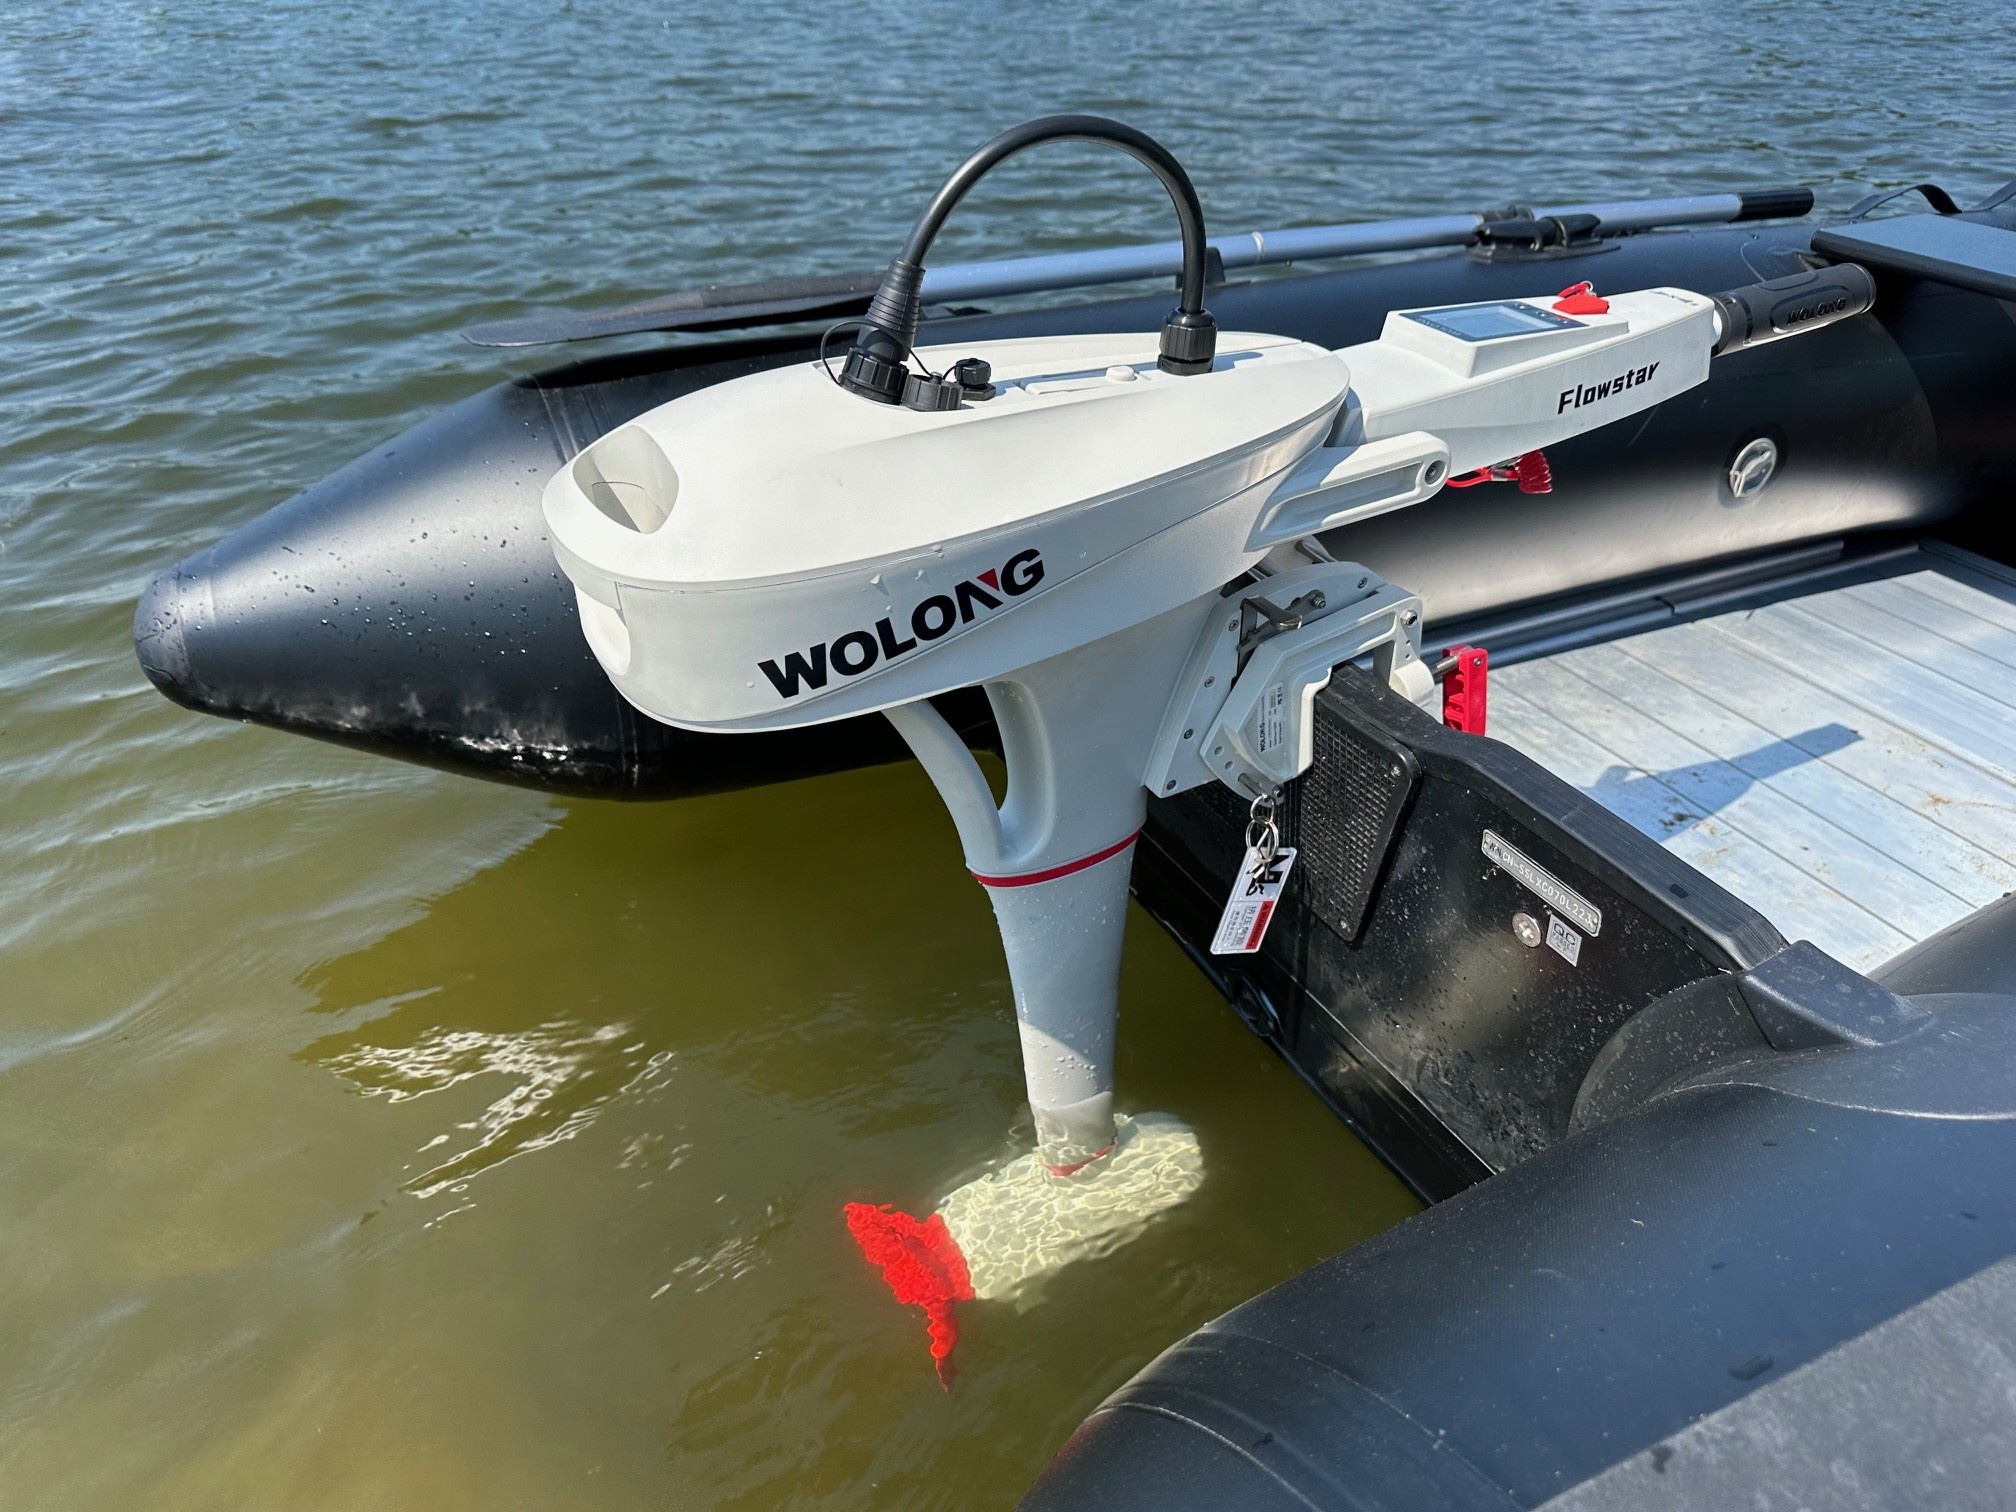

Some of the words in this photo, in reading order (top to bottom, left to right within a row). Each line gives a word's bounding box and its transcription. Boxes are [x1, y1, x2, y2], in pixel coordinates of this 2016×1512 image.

[1786, 297, 1846, 325] WOLONG
[1558, 361, 1660, 415] Flowstar
[757, 548, 1045, 699] WOLONG
[1554, 923, 1576, 946] QC
